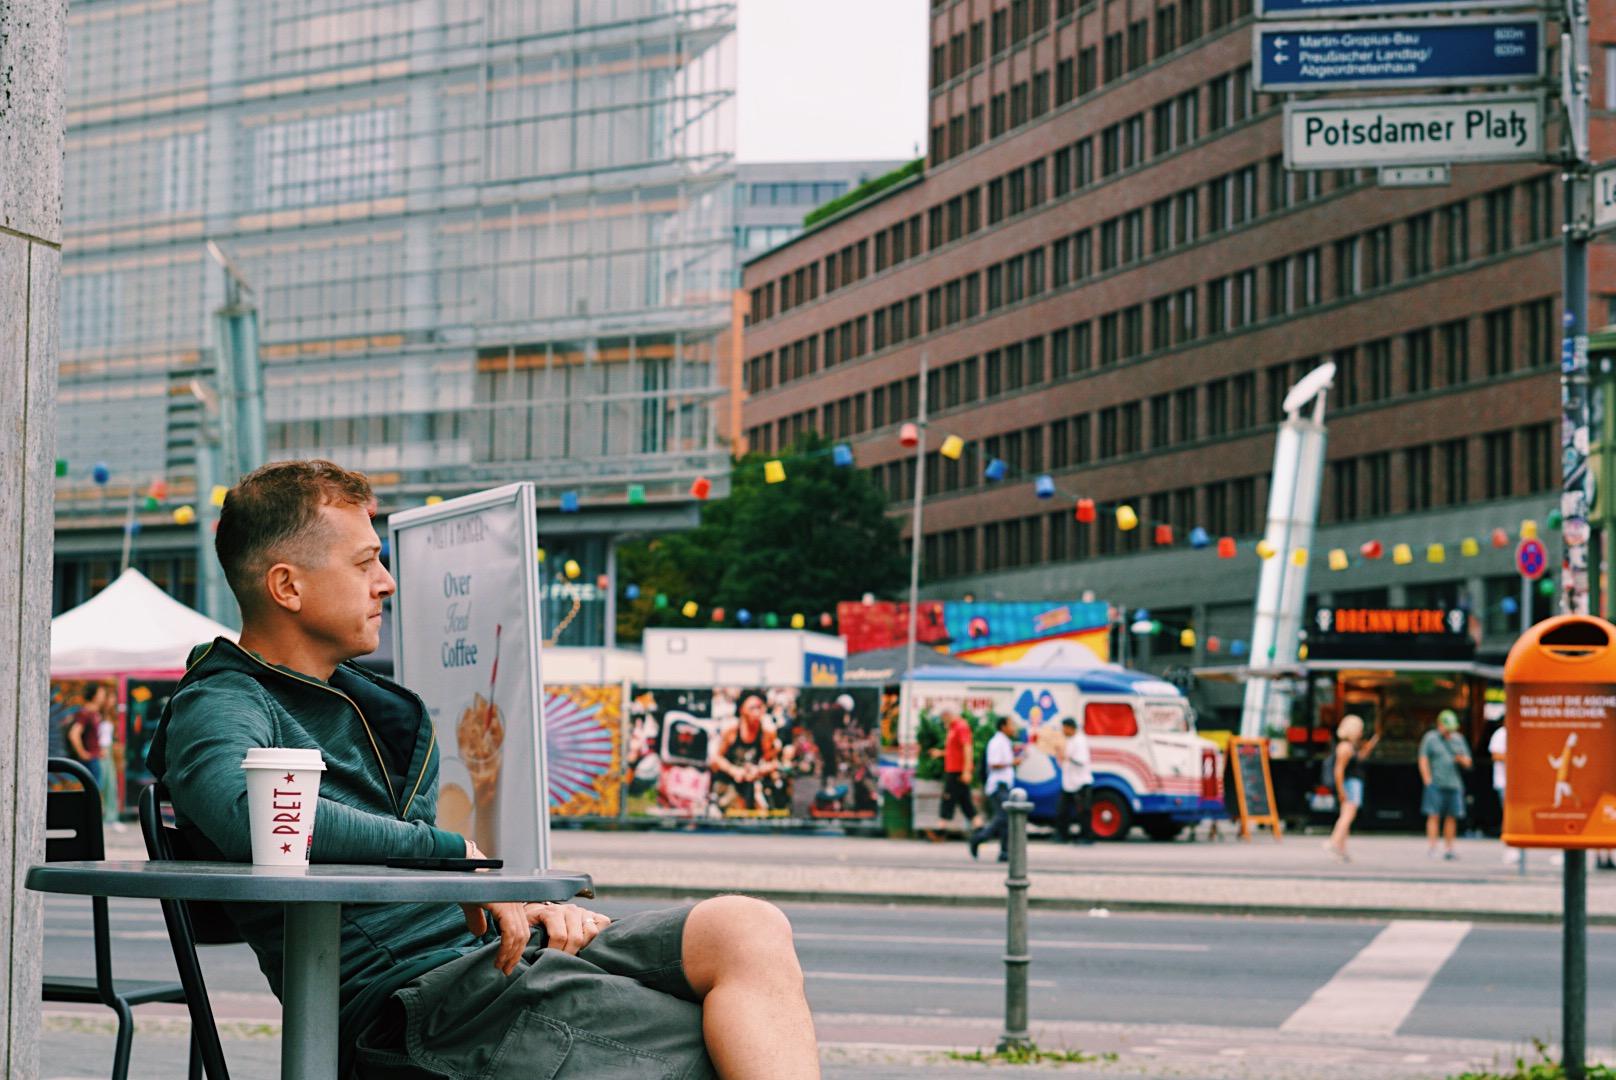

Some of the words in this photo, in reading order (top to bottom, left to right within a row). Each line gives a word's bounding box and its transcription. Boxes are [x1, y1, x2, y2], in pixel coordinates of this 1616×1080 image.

[1306, 114, 1454, 146] Potsdamer
[1465, 109, 1527, 147] Platz
[443, 571, 472, 598] Over
[441, 637, 478, 668] Coffee
[272, 788, 302, 835] PRET
